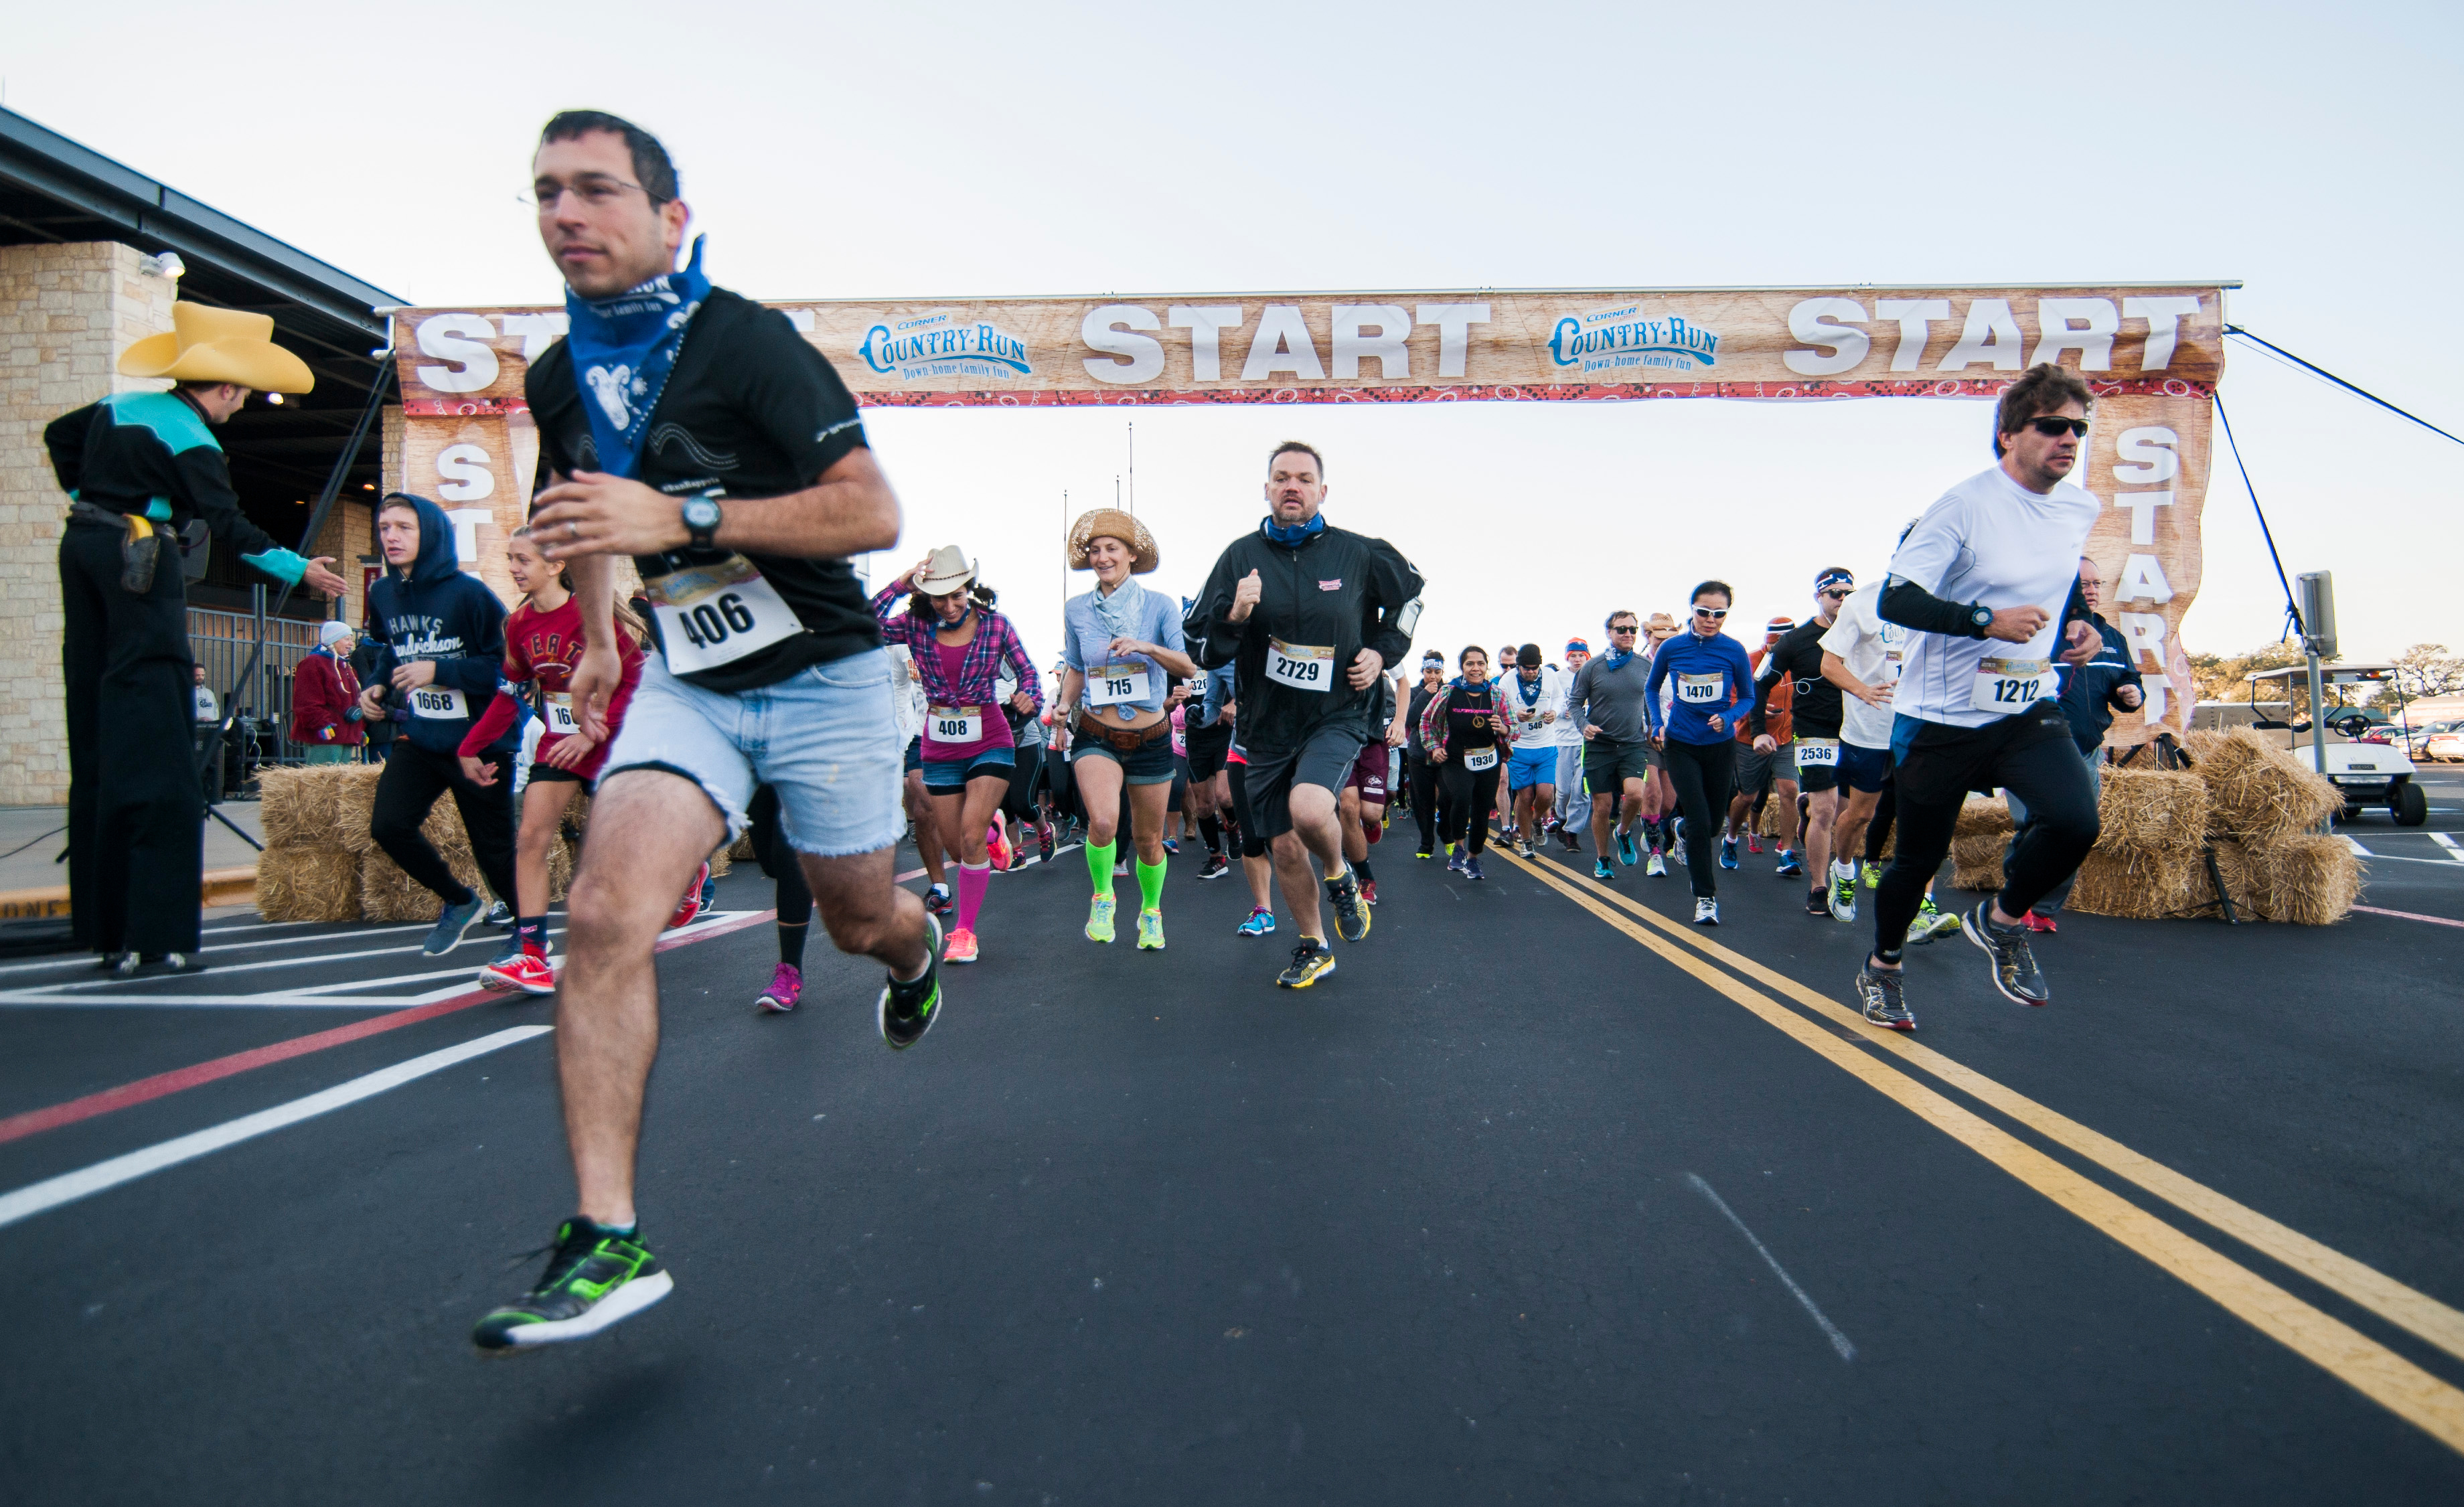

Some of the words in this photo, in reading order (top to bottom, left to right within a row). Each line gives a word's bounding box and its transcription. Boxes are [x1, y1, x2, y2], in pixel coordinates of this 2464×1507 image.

[897, 314, 947, 330] CORNER
[1587, 307, 1637, 323] CORNER
[1081, 303, 1491, 385] START
[1548, 317, 1663, 366] COUNTRY
[1667, 317, 1719, 353] RUN
[1782, 296, 2201, 376] START
[859, 325, 972, 373] COUNTRY
[977, 324, 1026, 362] RUN
[903, 364, 957, 380] Down-home
[960, 363, 990, 379] family
[993, 368, 1010, 379] fun
[1584, 355, 1640, 372] Down-home
[1643, 354, 1673, 369] family
[1676, 358, 1691, 370] fun
[2112, 426, 2179, 726] START
[388, 615, 443, 635] HAWKS
[678, 592, 755, 649] 406
[1276, 657, 1319, 681] 2729
[1107, 678, 1132, 696] 715
[1685, 685, 1713, 698] 1470
[1993, 679, 2039, 703] 1212
[416, 692, 454, 710] 1668
[938, 720, 968, 736] 408
[1528, 721, 1543, 730] 546
[1470, 753, 1493, 767] 1930
[1801, 747, 1831, 760] 2536
